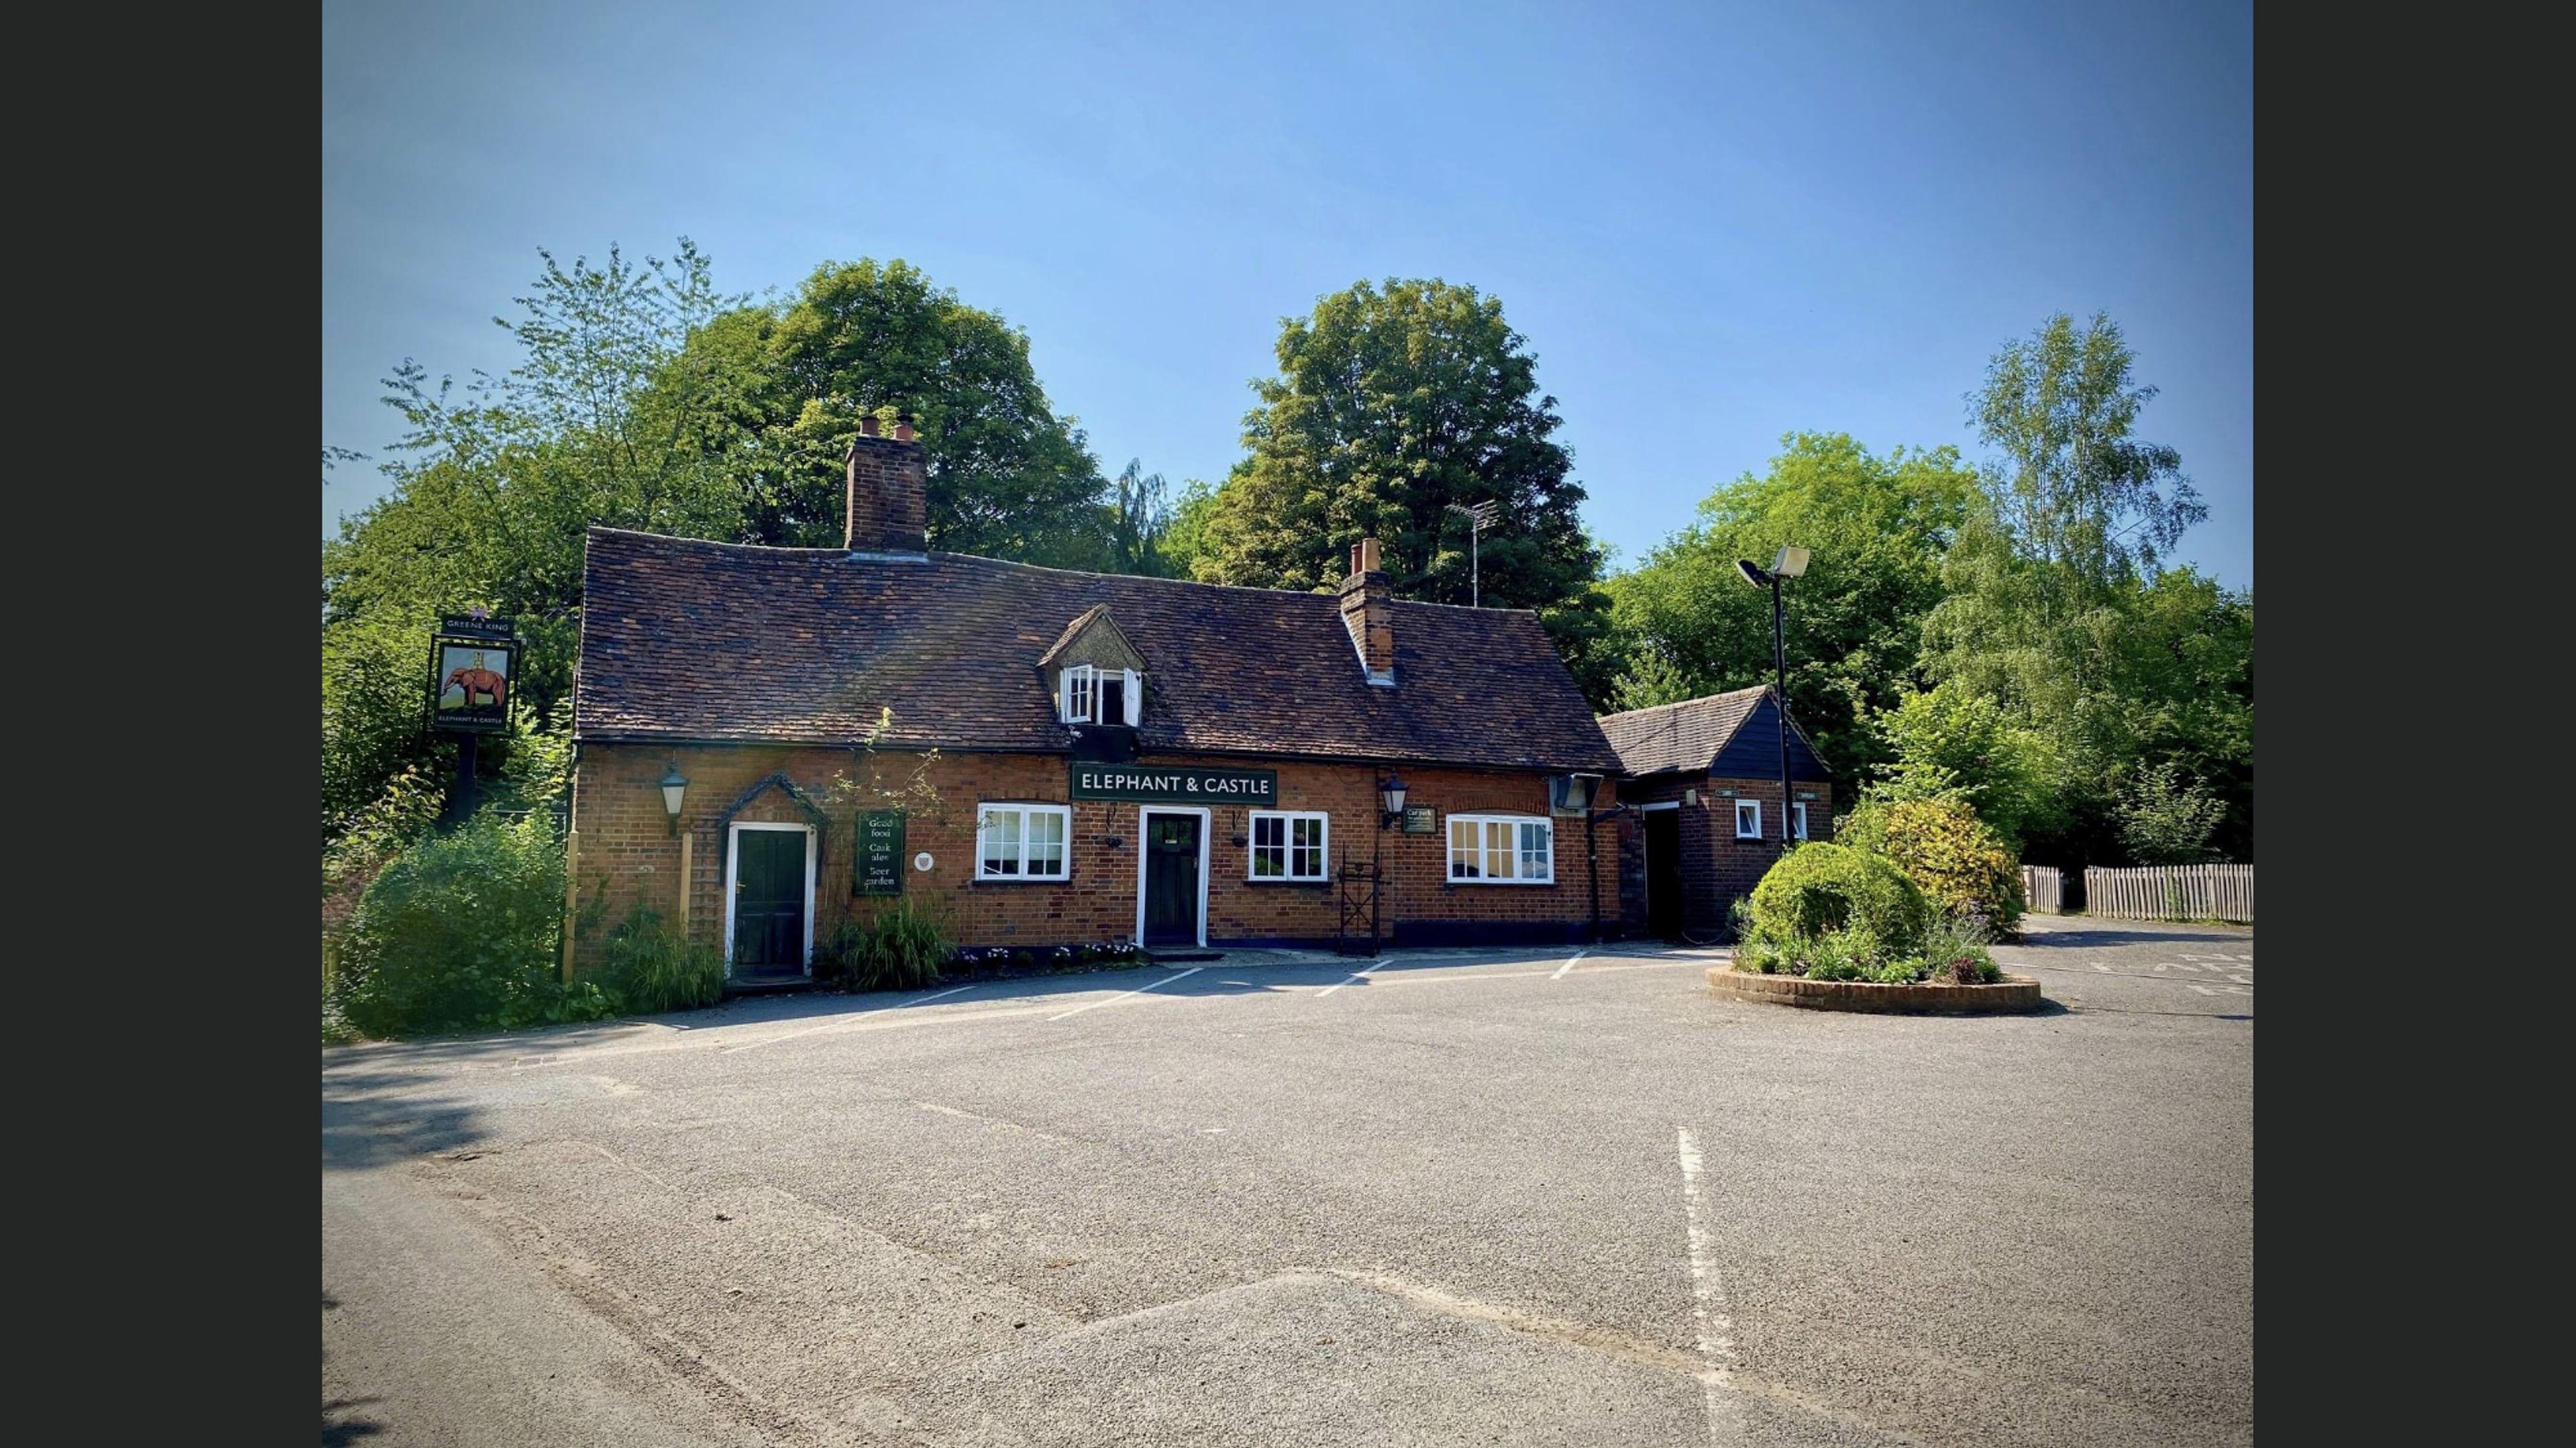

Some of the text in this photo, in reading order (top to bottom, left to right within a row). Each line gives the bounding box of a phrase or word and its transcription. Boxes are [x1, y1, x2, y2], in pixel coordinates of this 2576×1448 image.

[447, 620, 482, 629] GREENE
[1081, 773, 1269, 794] ELEPHANT & CASTLE
[869, 818, 893, 828] Good
[871, 829, 891, 838] food
[869, 843, 891, 852] Cask
[871, 853, 890, 862] ales
[869, 867, 890, 875] Beer
[864, 877, 894, 890] garden
